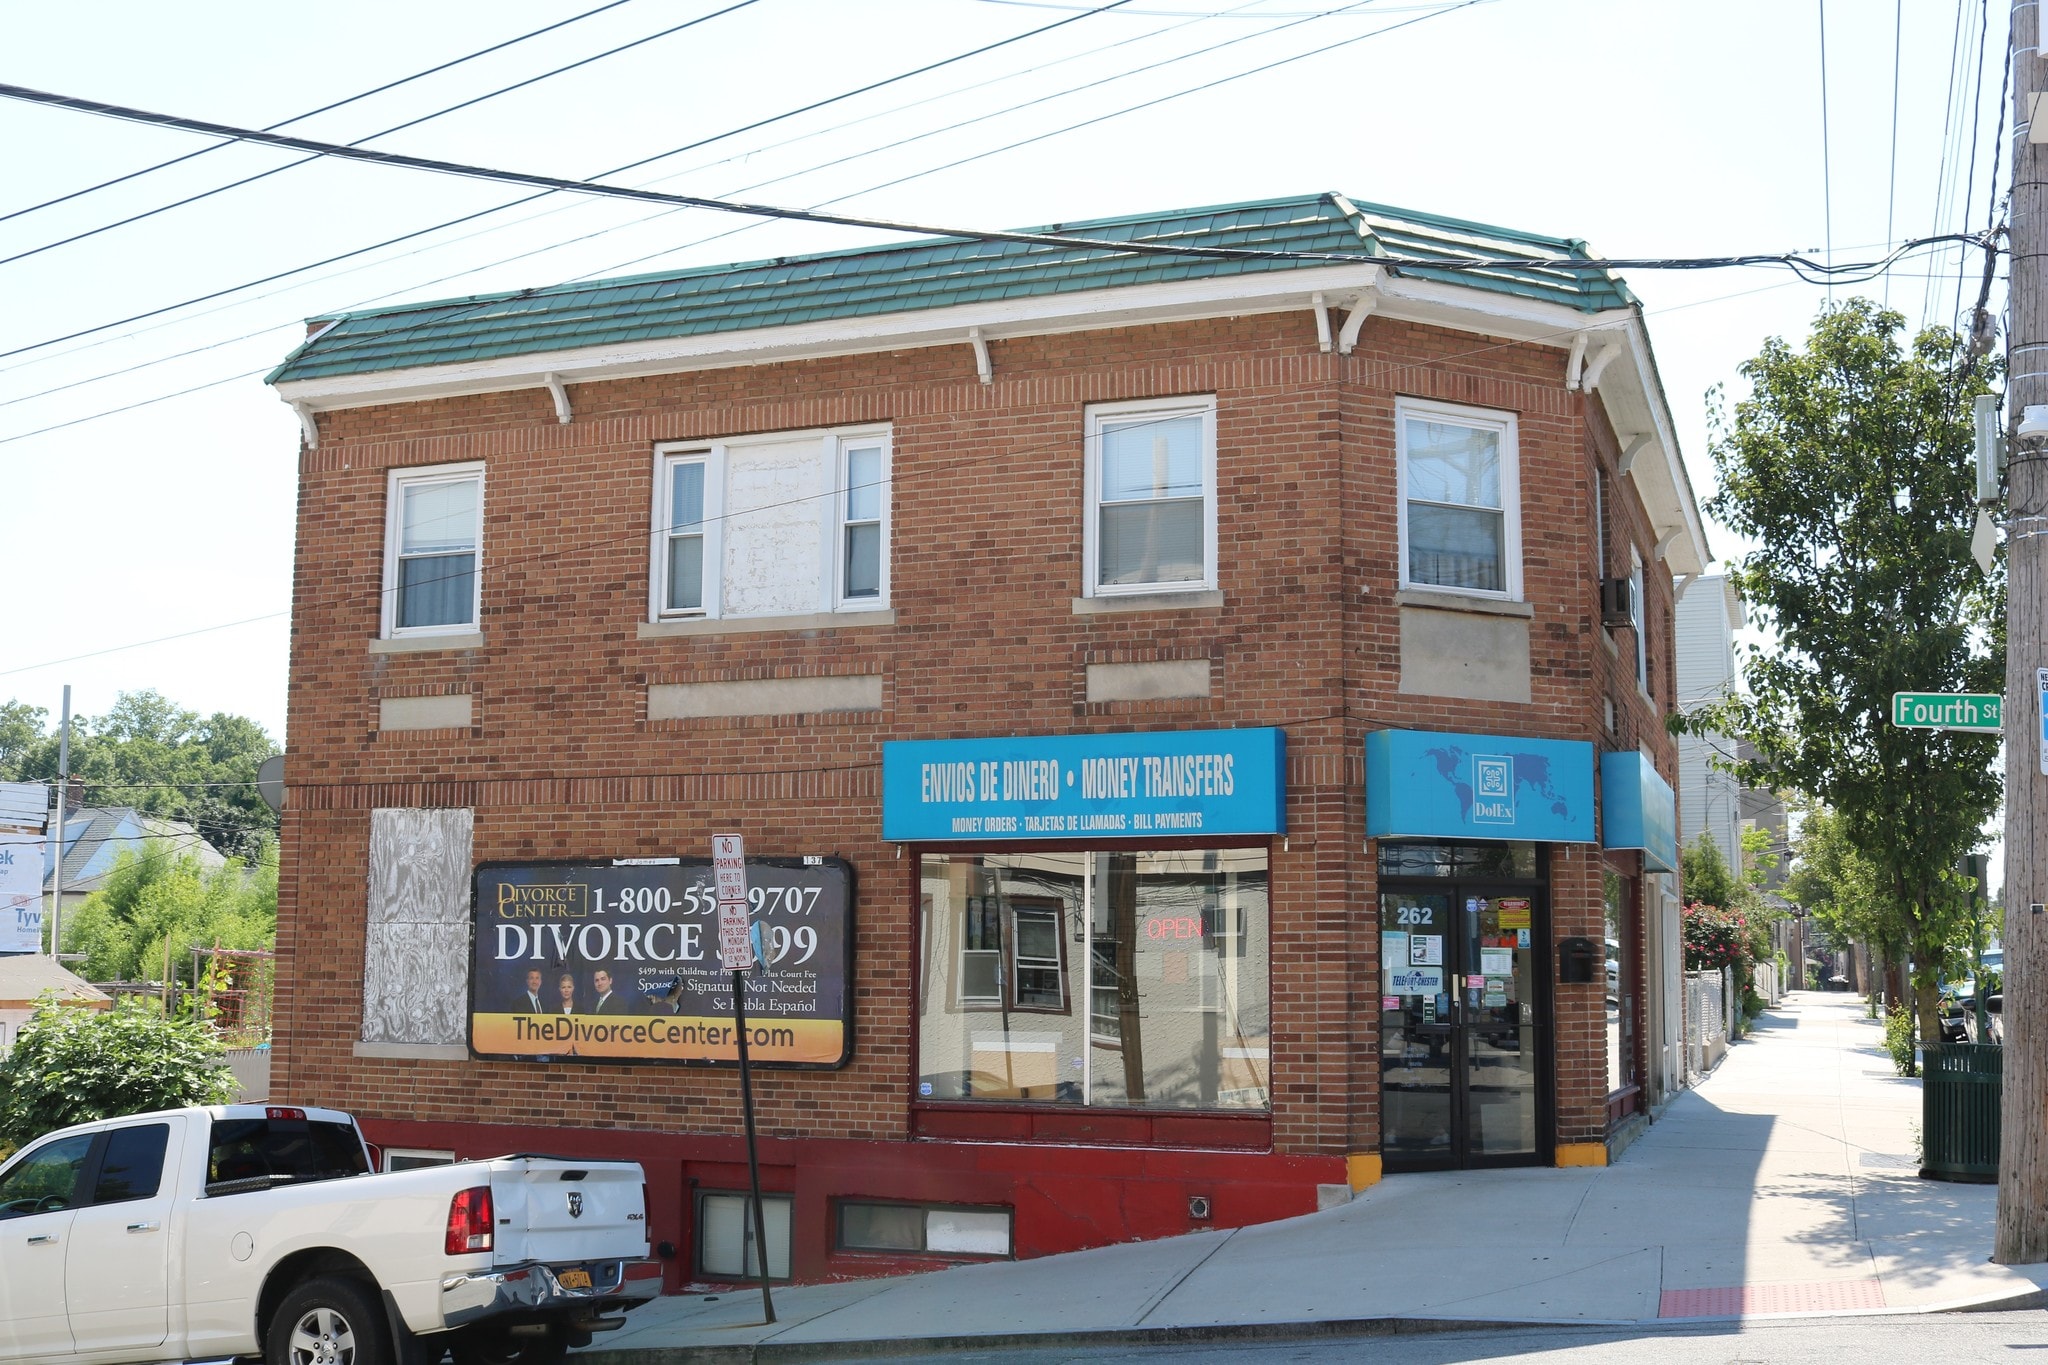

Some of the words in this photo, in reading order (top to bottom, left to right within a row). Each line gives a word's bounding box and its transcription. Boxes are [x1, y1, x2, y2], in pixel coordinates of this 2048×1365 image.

[1900, 698, 1978, 723] Fourth
[1983, 704, 1998, 718] St
[922, 762, 974, 802] ENVIOS
[980, 761, 998, 801] DE
[1003, 759, 1058, 800] DINERO
[1082, 757, 1138, 799] MONEY
[1143, 753, 1234, 797] TRANSFERS
[1475, 802, 1512, 818] DolEx
[952, 817, 983, 833] MONEY
[984, 816, 1016, 832] ORDERS
[1024, 815, 1064, 831] TARJETAS
[1067, 815, 1078, 830] DE
[1080, 814, 1126, 830] LLAMADAS
[1134, 814, 1152, 830] BILL
[1154, 812, 1202, 829] PAYMENTS
[722, 841, 733, 854] NO
[716, 857, 743, 870] PARKING
[720, 872, 732, 882] HERE
[734, 872, 741, 882] TO
[497, 883, 576, 903] DIVORCE
[722, 885, 741, 896] CORNER
[499, 898, 569, 918] CENTER
[594, 886, 822, 916] 1-800-559707
[730, 905, 737, 915] NO
[1397, 907, 1433, 925] 262
[723, 917, 745, 926] PARKING
[1148, 917, 1204, 940] OPEN
[722, 927, 734, 936] THIS
[736, 926, 748, 936] SIDE
[495, 923, 704, 962] DIVORCE
[727, 936, 745, 946] MONDAY
[638, 967, 656, 976] $499
[658, 967, 674, 976] with
[720, 968, 752, 979] Prorty
[780, 970, 802, 978] Court
[804, 970, 817, 978] Fee
[687, 978, 734, 994] Signatur
[744, 980, 767, 992] Not
[771, 980, 816, 994] Needed
[712, 997, 727, 1010] Se
[769, 998, 816, 1015] Español
[513, 1016, 794, 1047] TheDivorceCenter.com
